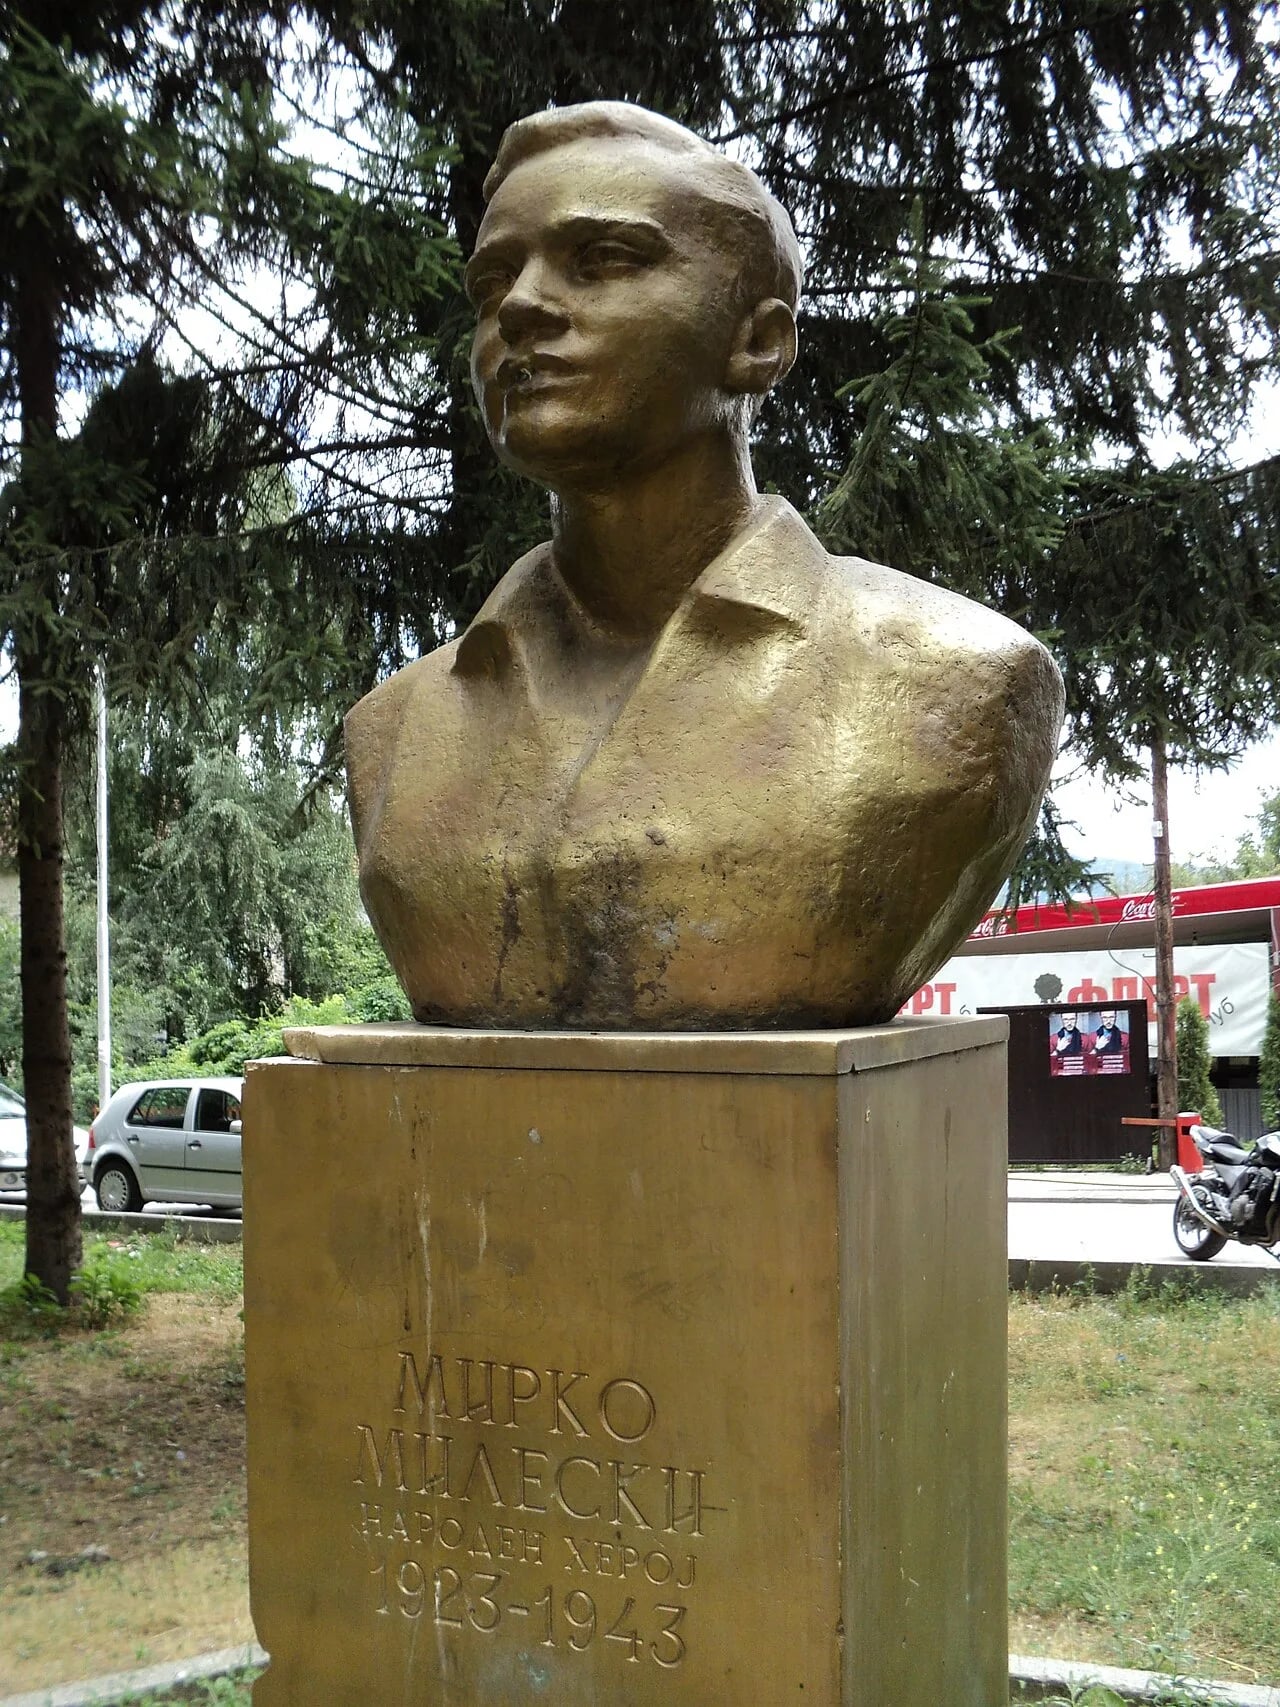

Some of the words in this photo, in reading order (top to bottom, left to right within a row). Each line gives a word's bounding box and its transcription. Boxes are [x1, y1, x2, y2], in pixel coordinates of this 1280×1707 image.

[393, 1351, 657, 1443] МИРКО
[352, 1424, 706, 1538] МИЛЕСКИ
[359, 1502, 544, 1565] НАРОДЕН
[564, 1536, 698, 1589] ХЕРОЈ
[369, 1558, 688, 1668] 1923-1943
